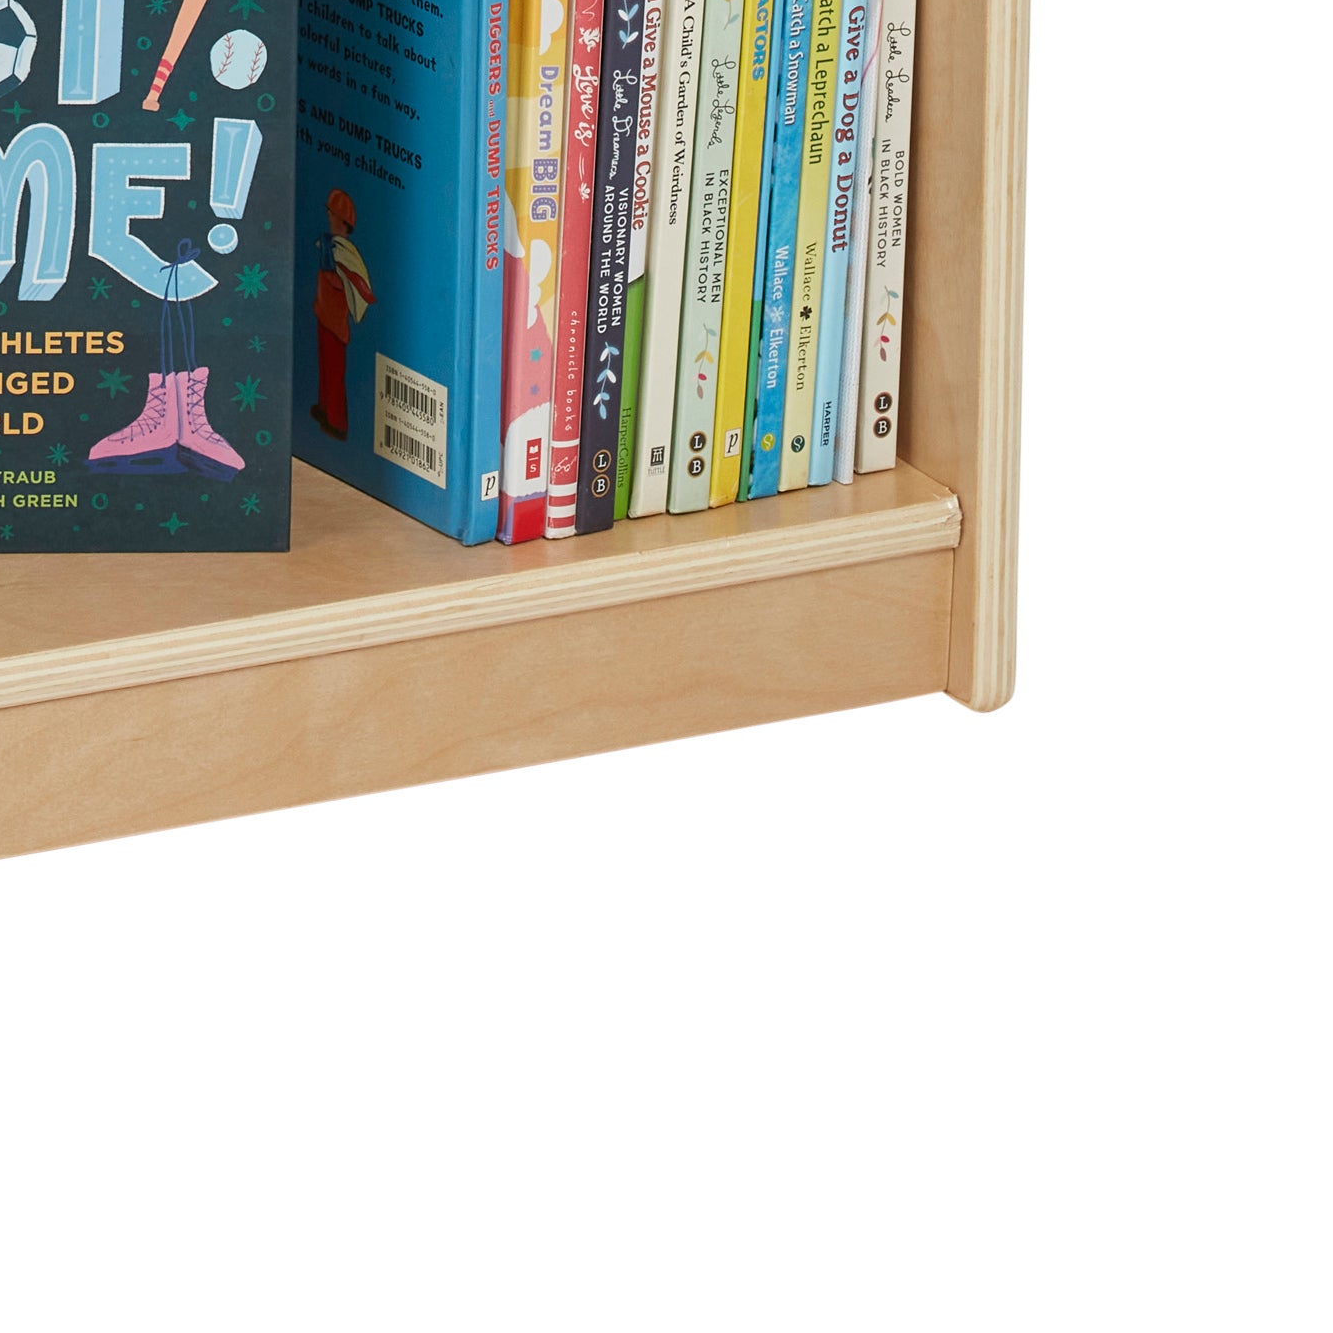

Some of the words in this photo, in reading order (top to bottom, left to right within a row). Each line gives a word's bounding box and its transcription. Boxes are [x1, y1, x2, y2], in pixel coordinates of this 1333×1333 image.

[377, 2, 424, 37] TRUCKS
[844, 3, 867, 63] Give
[489, 2, 502, 96] DIGGERS
[844, 68, 858, 83] a
[538, 65, 559, 152] Dream
[573, 64, 599, 120] Love
[835, 89, 858, 144] Dog
[485, 120, 501, 178] DUMP
[837, 152, 852, 165] a
[531, 157, 558, 222] BIG
[602, 185, 614, 245] AROUND
[832, 173, 853, 252] Donut
[485, 185, 500, 271] TRUCKS
[617, 188, 629, 264] VISIONARY
[599, 251, 611, 278] THE
[597, 284, 609, 333] WORLD
[611, 269, 624, 327] WOMEN
[822, 401, 832, 447] HARPER
[13, 494, 78, 508] GREEN
